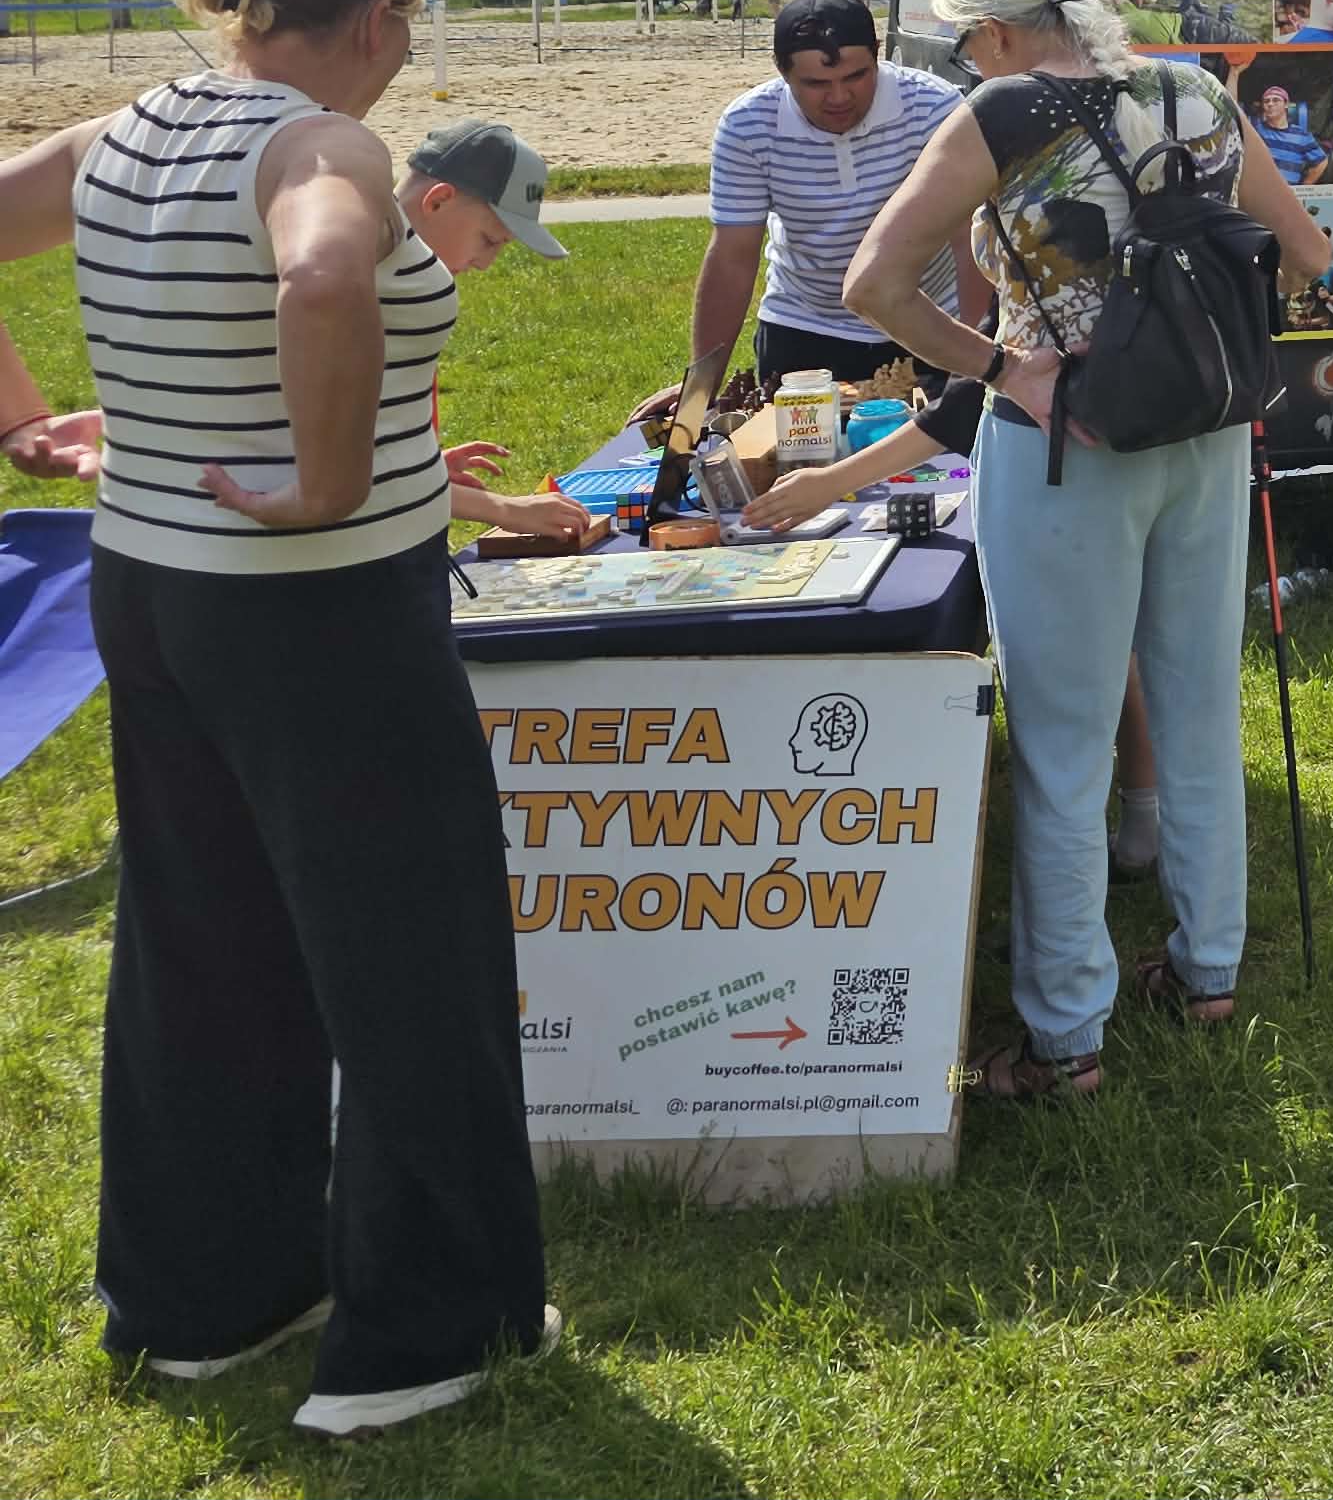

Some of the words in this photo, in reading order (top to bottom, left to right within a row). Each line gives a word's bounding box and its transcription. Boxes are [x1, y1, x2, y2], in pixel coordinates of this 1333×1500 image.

[778, 435, 832, 448] normalsi
[788, 425, 819, 438] para
[477, 707, 730, 764] TREFA
[498, 787, 938, 849] TYWNYCH
[506, 857, 886, 932] URONÓW
[634, 989, 713, 1029] chcesz
[718, 970, 766, 998] nam
[520, 1016, 573, 1041] alsi
[618, 1007, 720, 1062] postawić
[725, 979, 797, 1018] kawę?
[705, 1060, 903, 1079] buycoffee.to/paranormalsi
[667, 1097, 688, 1115] @:
[692, 1094, 920, 1115] paranormalsi.pl@gmail.com
